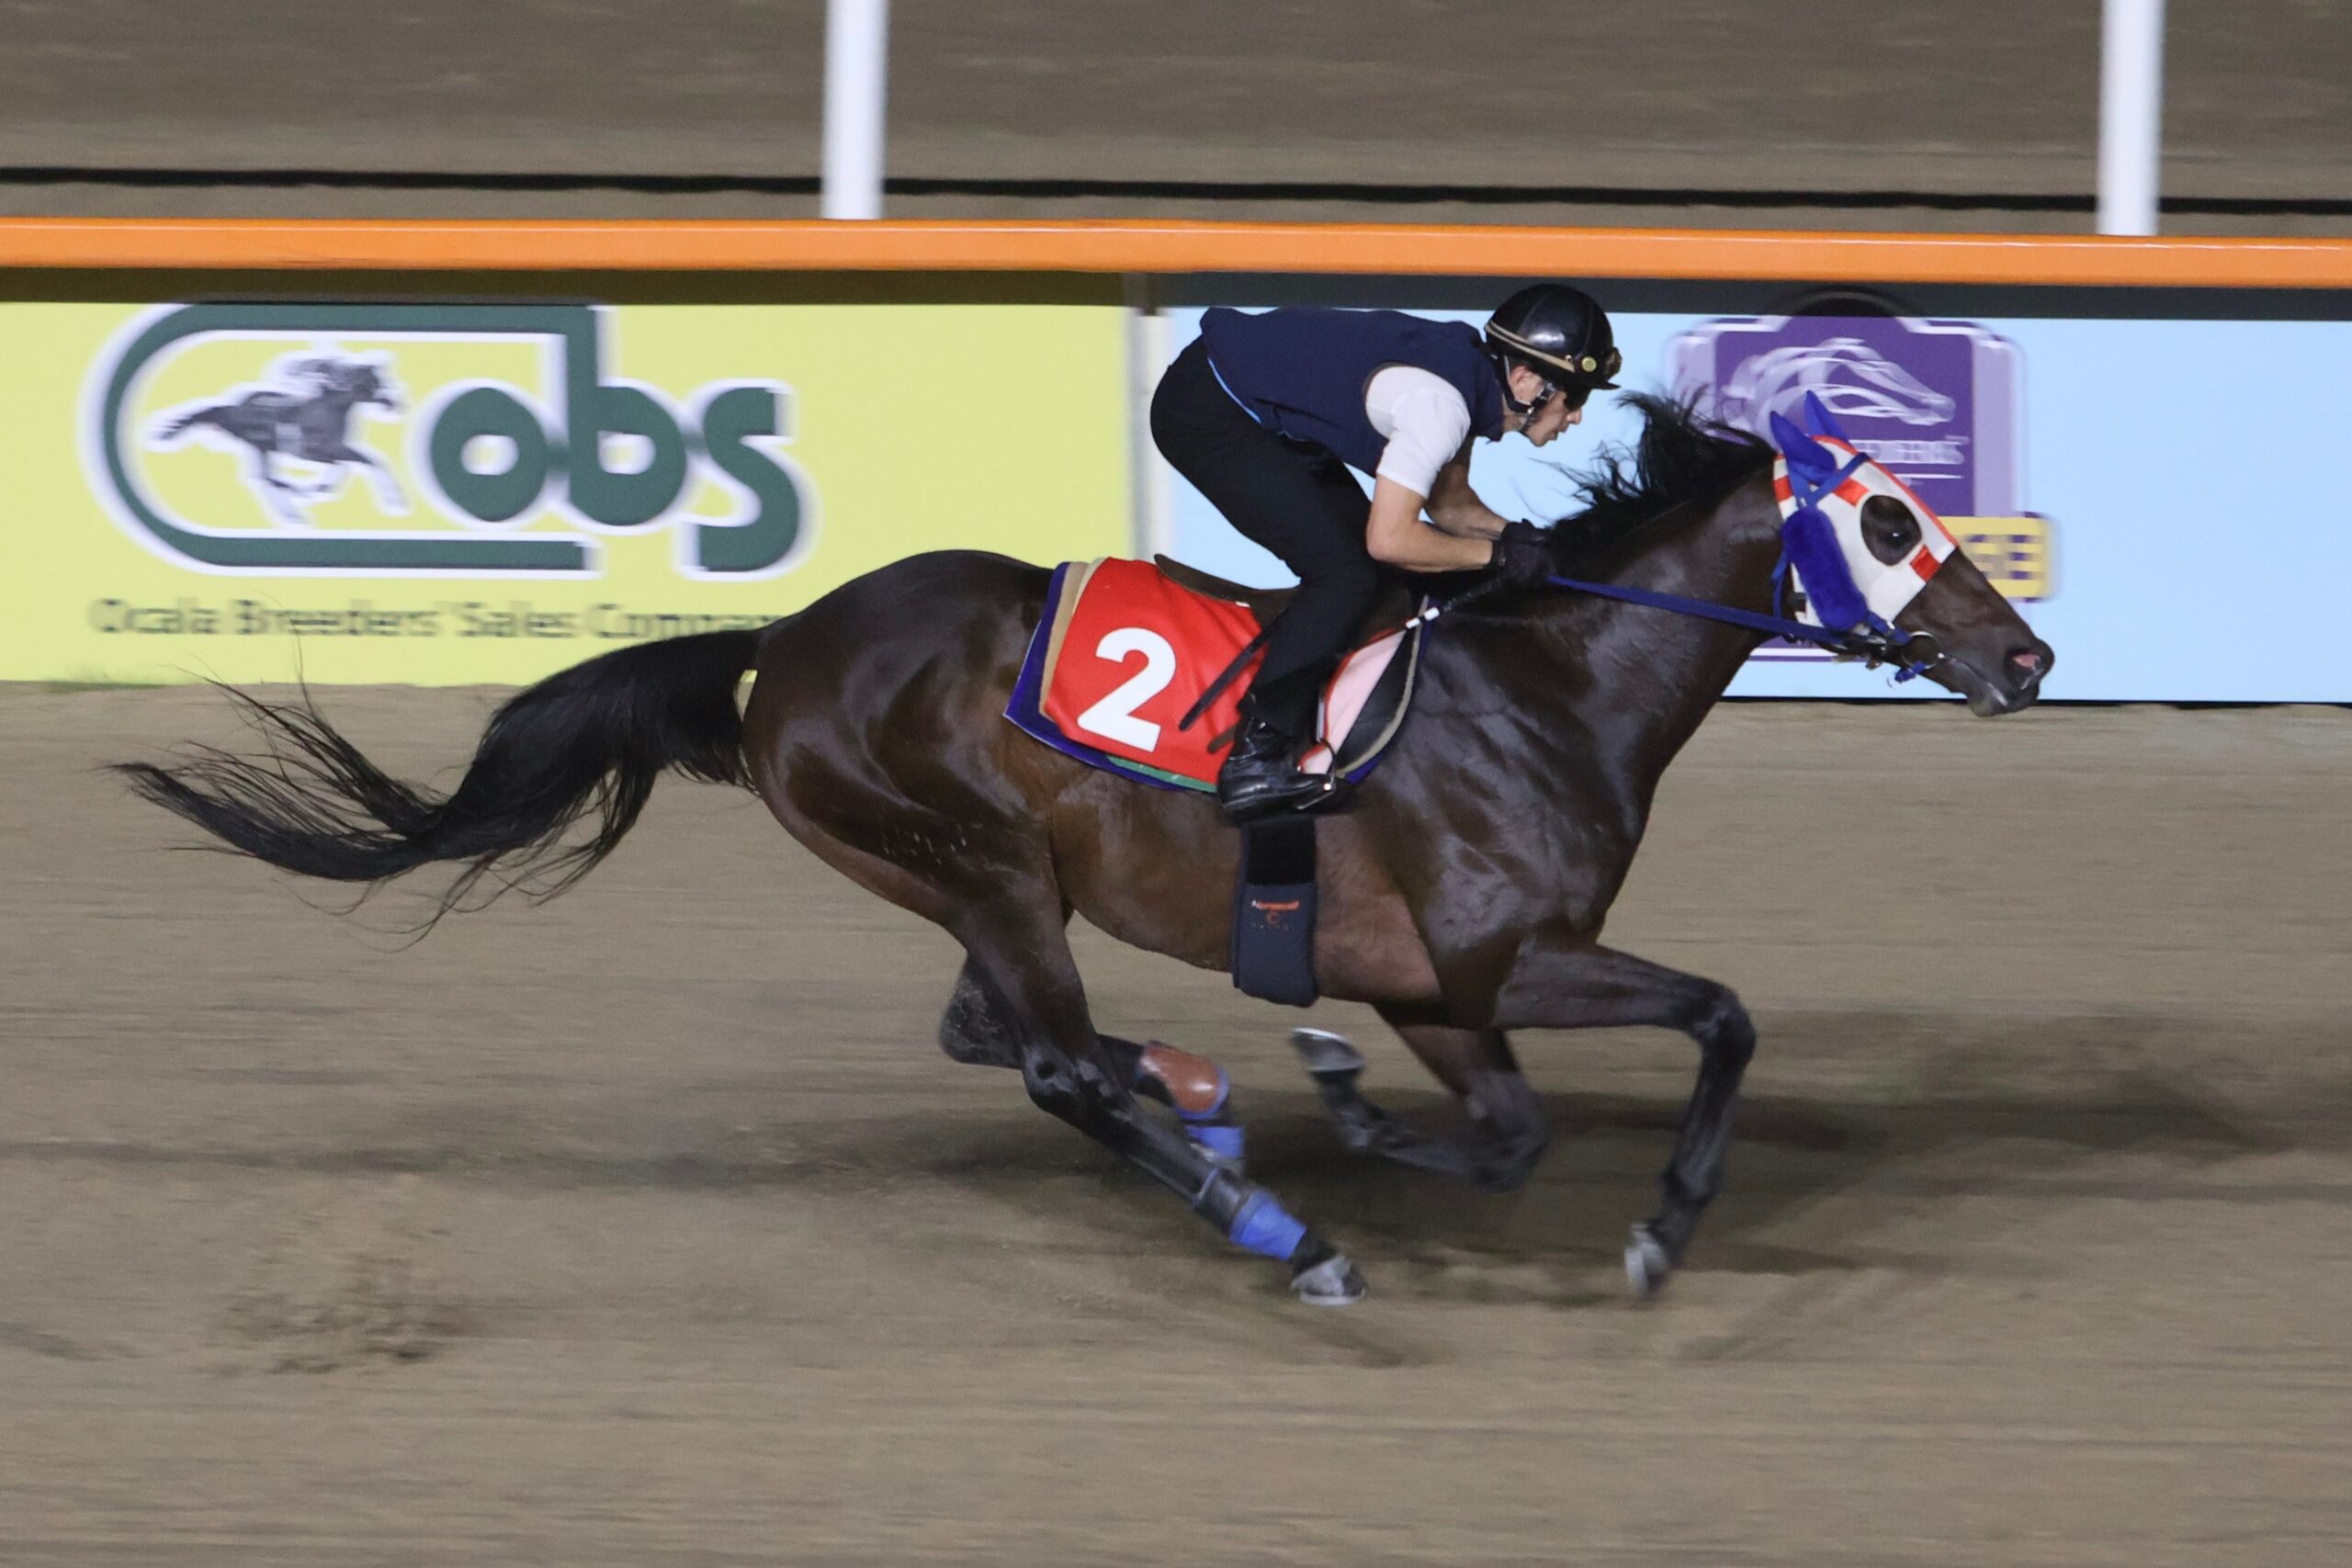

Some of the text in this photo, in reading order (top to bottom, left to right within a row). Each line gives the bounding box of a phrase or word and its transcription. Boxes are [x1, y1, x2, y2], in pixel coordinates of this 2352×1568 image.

[424, 305, 807, 574] obs
[89, 598, 220, 636] Ocala
[454, 600, 582, 637] Sales
[1078, 627, 1176, 752] 2
